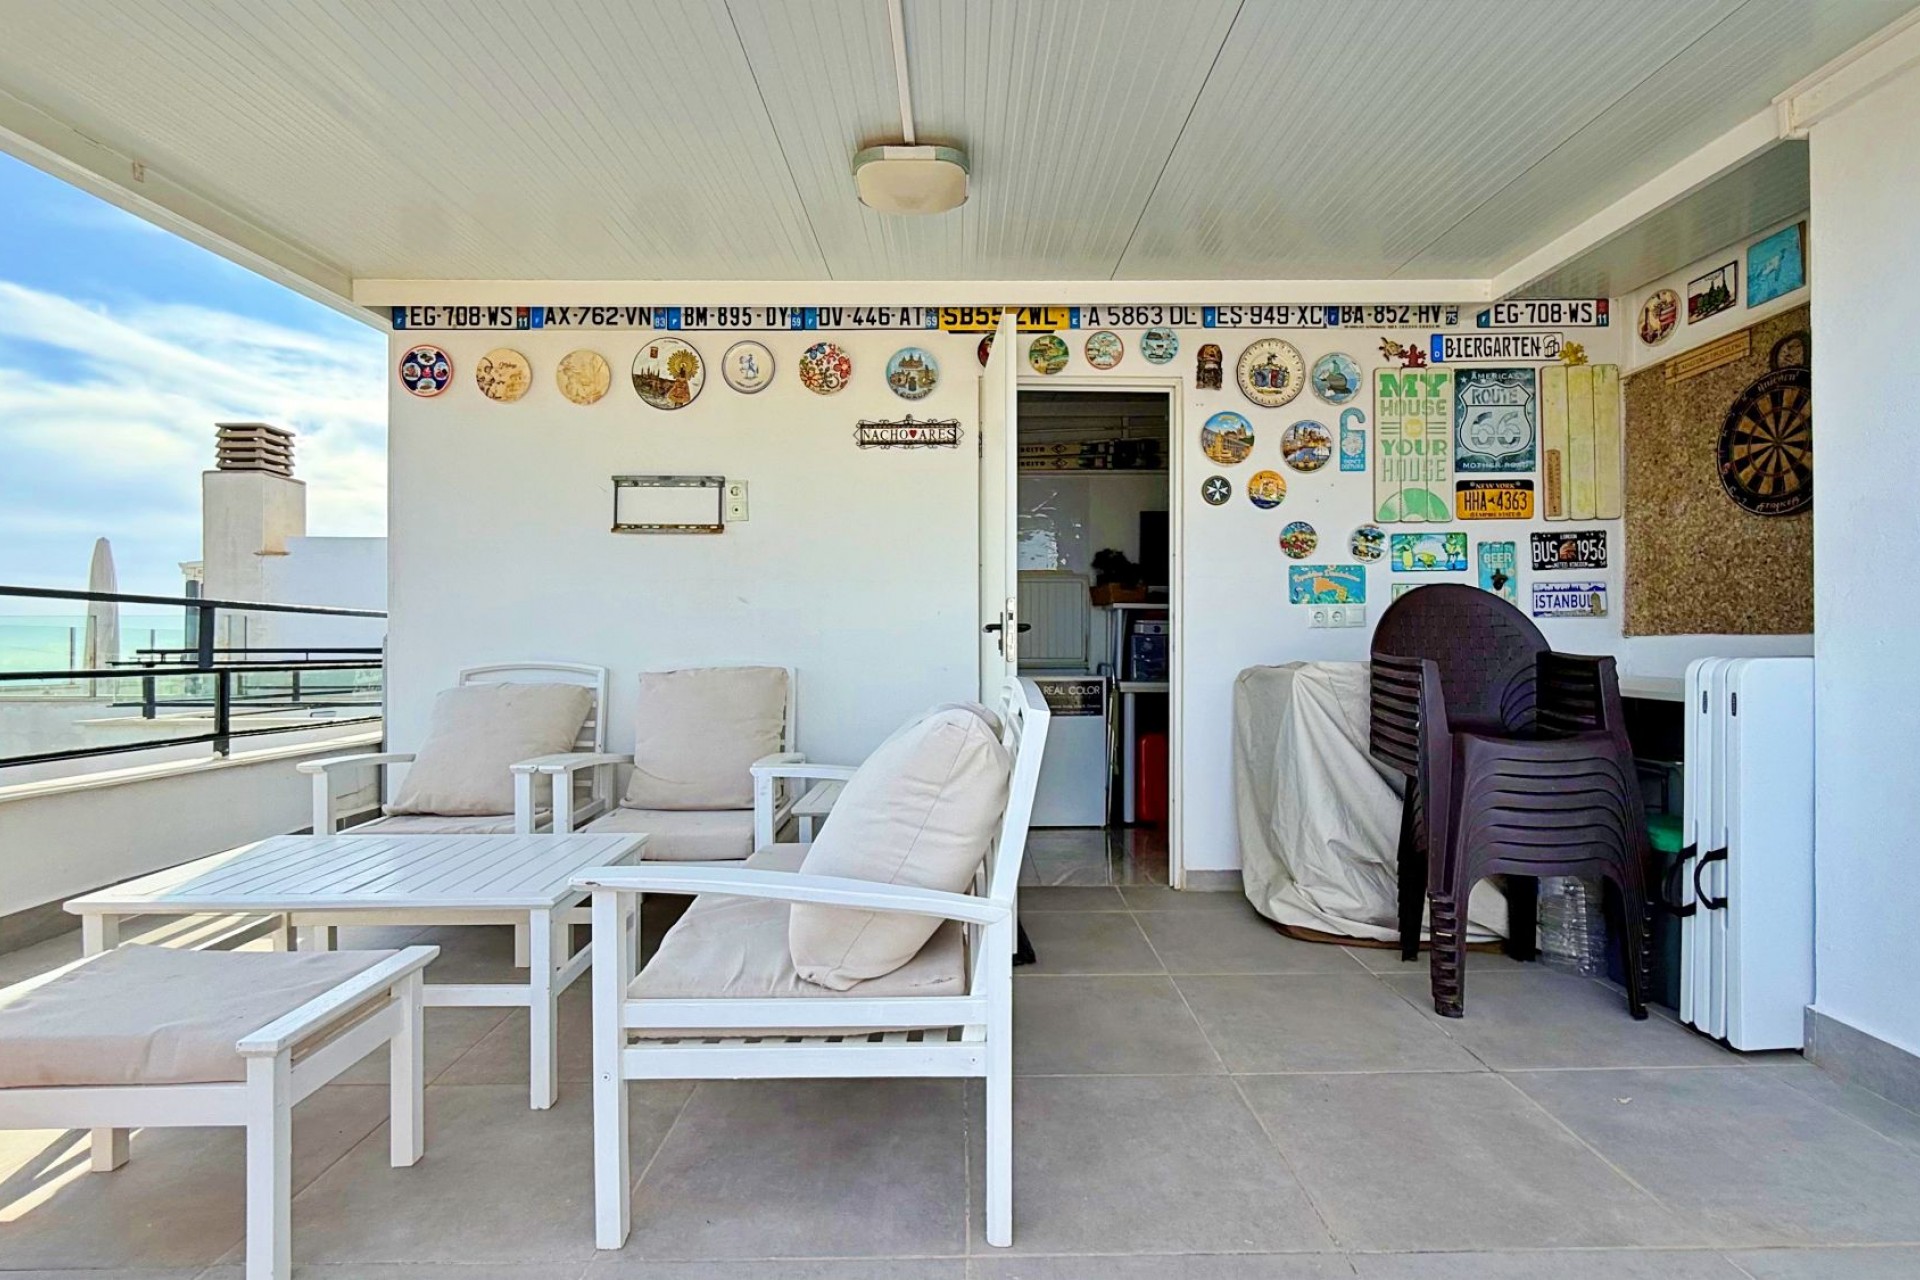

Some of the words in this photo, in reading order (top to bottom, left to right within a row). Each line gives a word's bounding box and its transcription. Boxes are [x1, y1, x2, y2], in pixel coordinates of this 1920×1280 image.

[410, 307, 512, 326] EG-708-WS
[518, 317, 529, 328] 11
[544, 307, 651, 326] AX-762-VN
[791, 317, 801, 327] 59
[818, 307, 922, 326] DV-446-AT
[1107, 307, 1163, 326] 5863
[1170, 307, 1197, 325] DL
[1217, 306, 1323, 325] ES-949-XC
[1494, 303, 1593, 324] EG-708-WS
[1445, 336, 1540, 359] BIERGARTEN
[1379, 373, 1448, 398] MY
[1471, 388, 1518, 404] ROUTE
[1380, 399, 1447, 416] HOUSE
[863, 429, 908, 440] NACHO
[919, 428, 956, 441] ARES
[1471, 411, 1521, 449] 66
[1380, 439, 1448, 456] YOUR
[1381, 458, 1447, 482] HOUSE
[1464, 491, 1487, 511] HHA
[1496, 491, 1527, 511] 4363
[1483, 552, 1511, 563] BEER
[1532, 541, 1559, 563] BUS
[1577, 539, 1606, 562] 1956
[1044, 685, 1066, 695] REAL
[1068, 685, 1100, 695] COLOR
